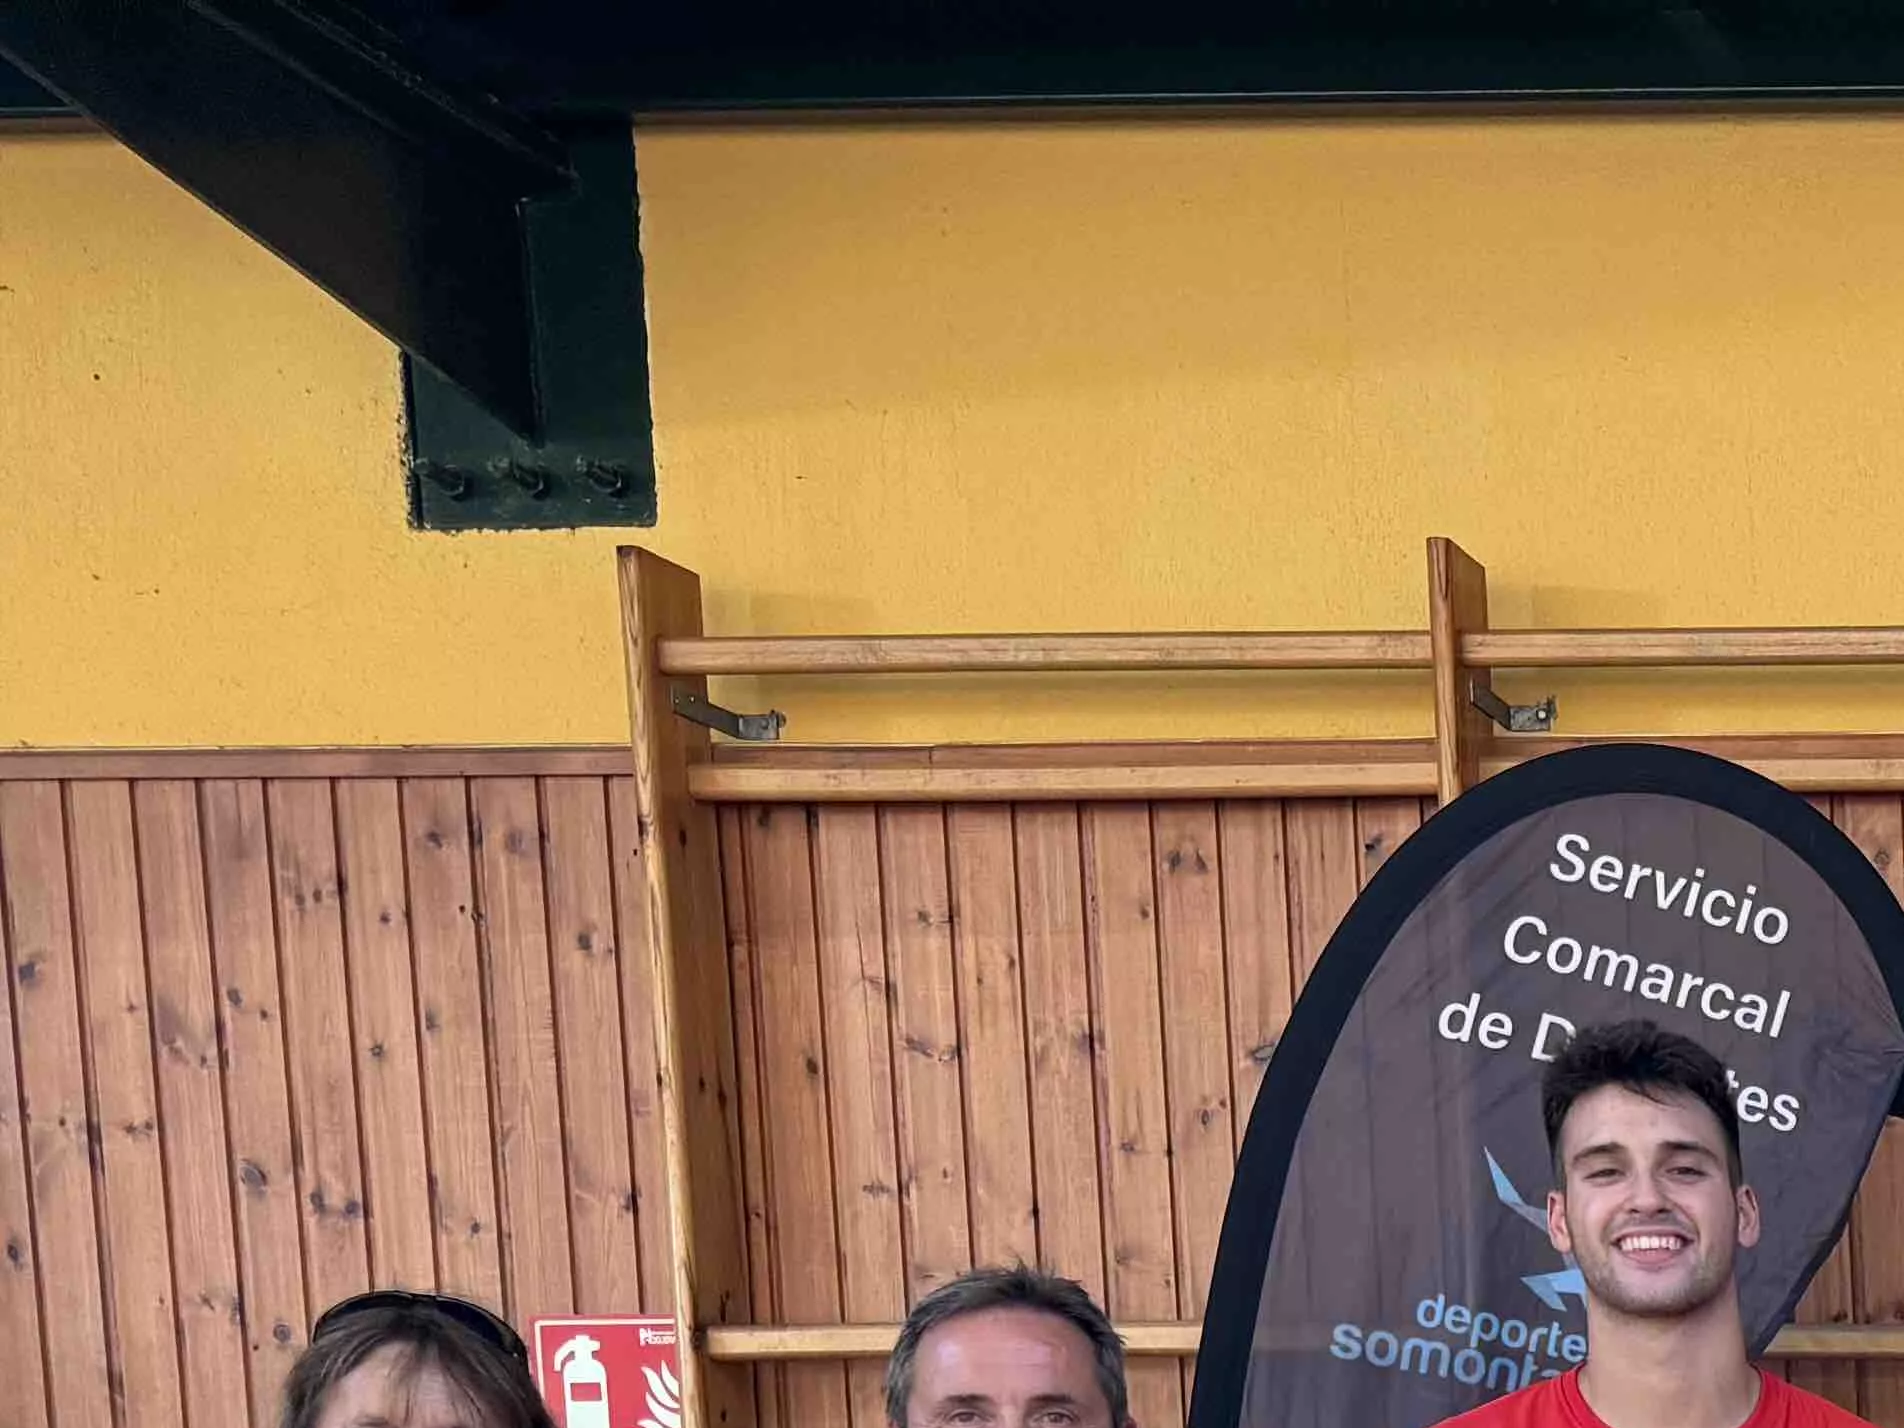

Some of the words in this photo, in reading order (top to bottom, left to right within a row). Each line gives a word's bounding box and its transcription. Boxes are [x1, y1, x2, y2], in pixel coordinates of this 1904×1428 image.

[1549, 833, 1789, 944] Servicio
[1438, 992, 1513, 1049] de
[1503, 915, 1791, 1038] Comarcal
[1416, 1293, 1586, 1362] deporte
